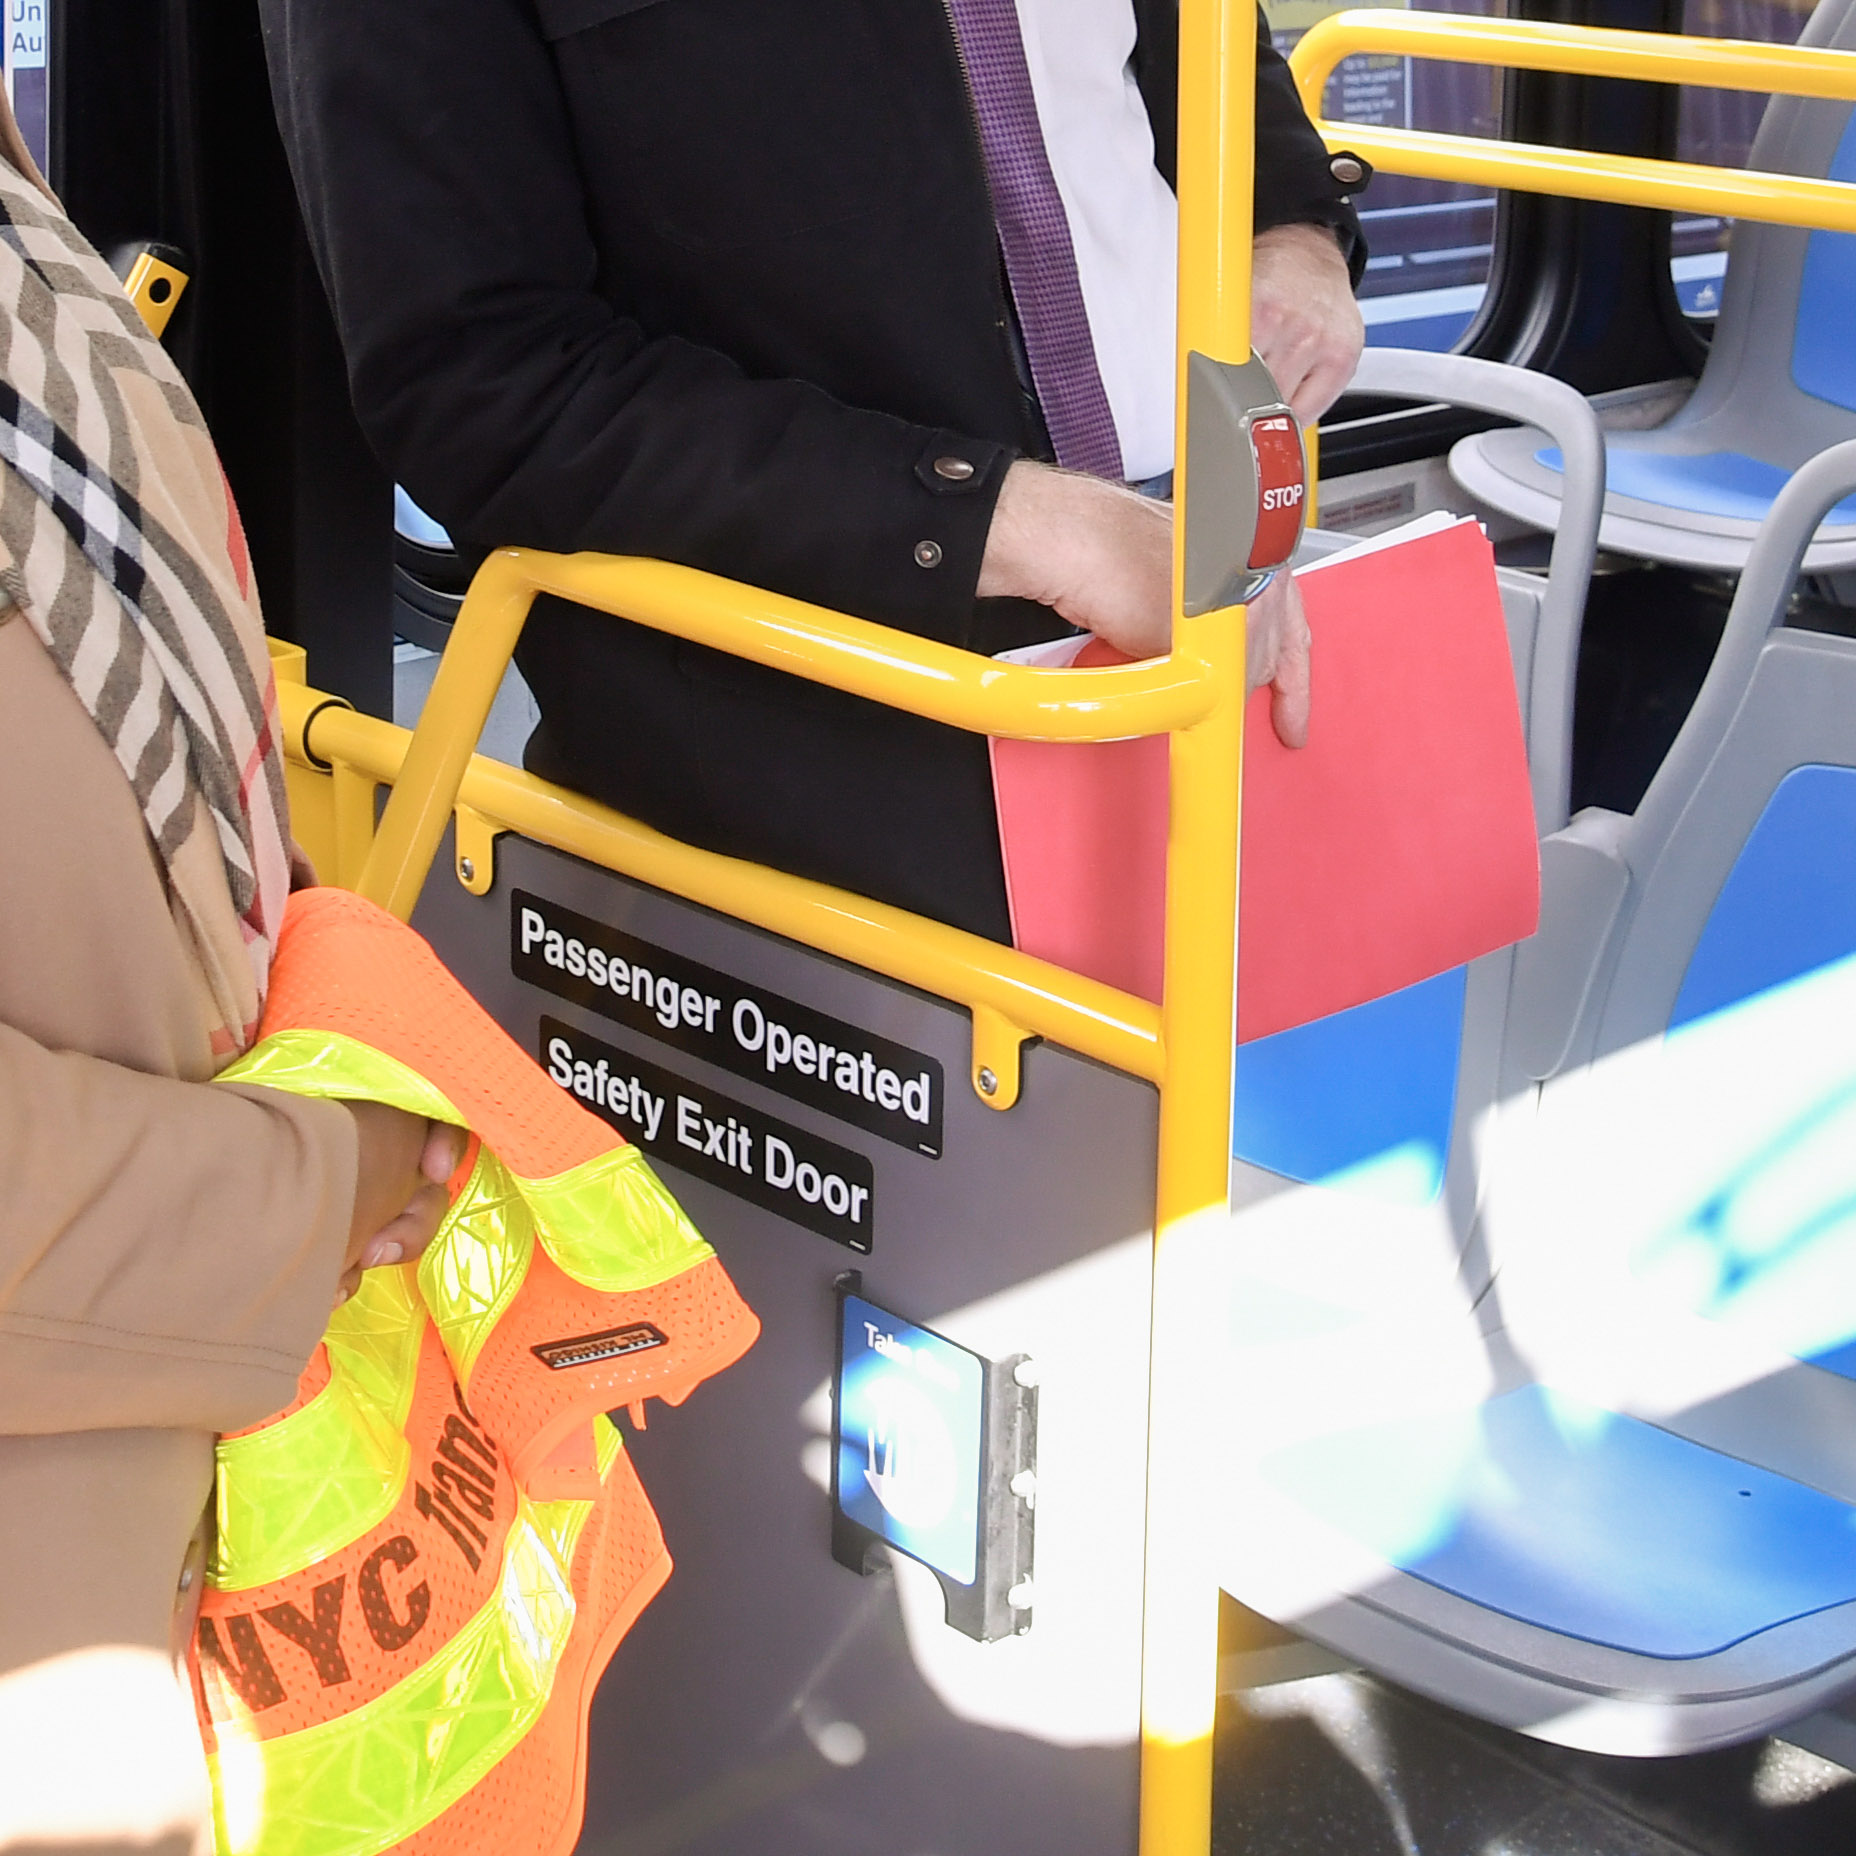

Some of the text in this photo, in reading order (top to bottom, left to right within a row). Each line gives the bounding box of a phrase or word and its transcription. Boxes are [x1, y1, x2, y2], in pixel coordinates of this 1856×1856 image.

[1262, 483, 1304, 511] STOP
[519, 906, 931, 1125] Passenger Operated
[547, 1037, 869, 1224] Safety Exit Door
[197, 1380, 498, 1726] NYC Tran
